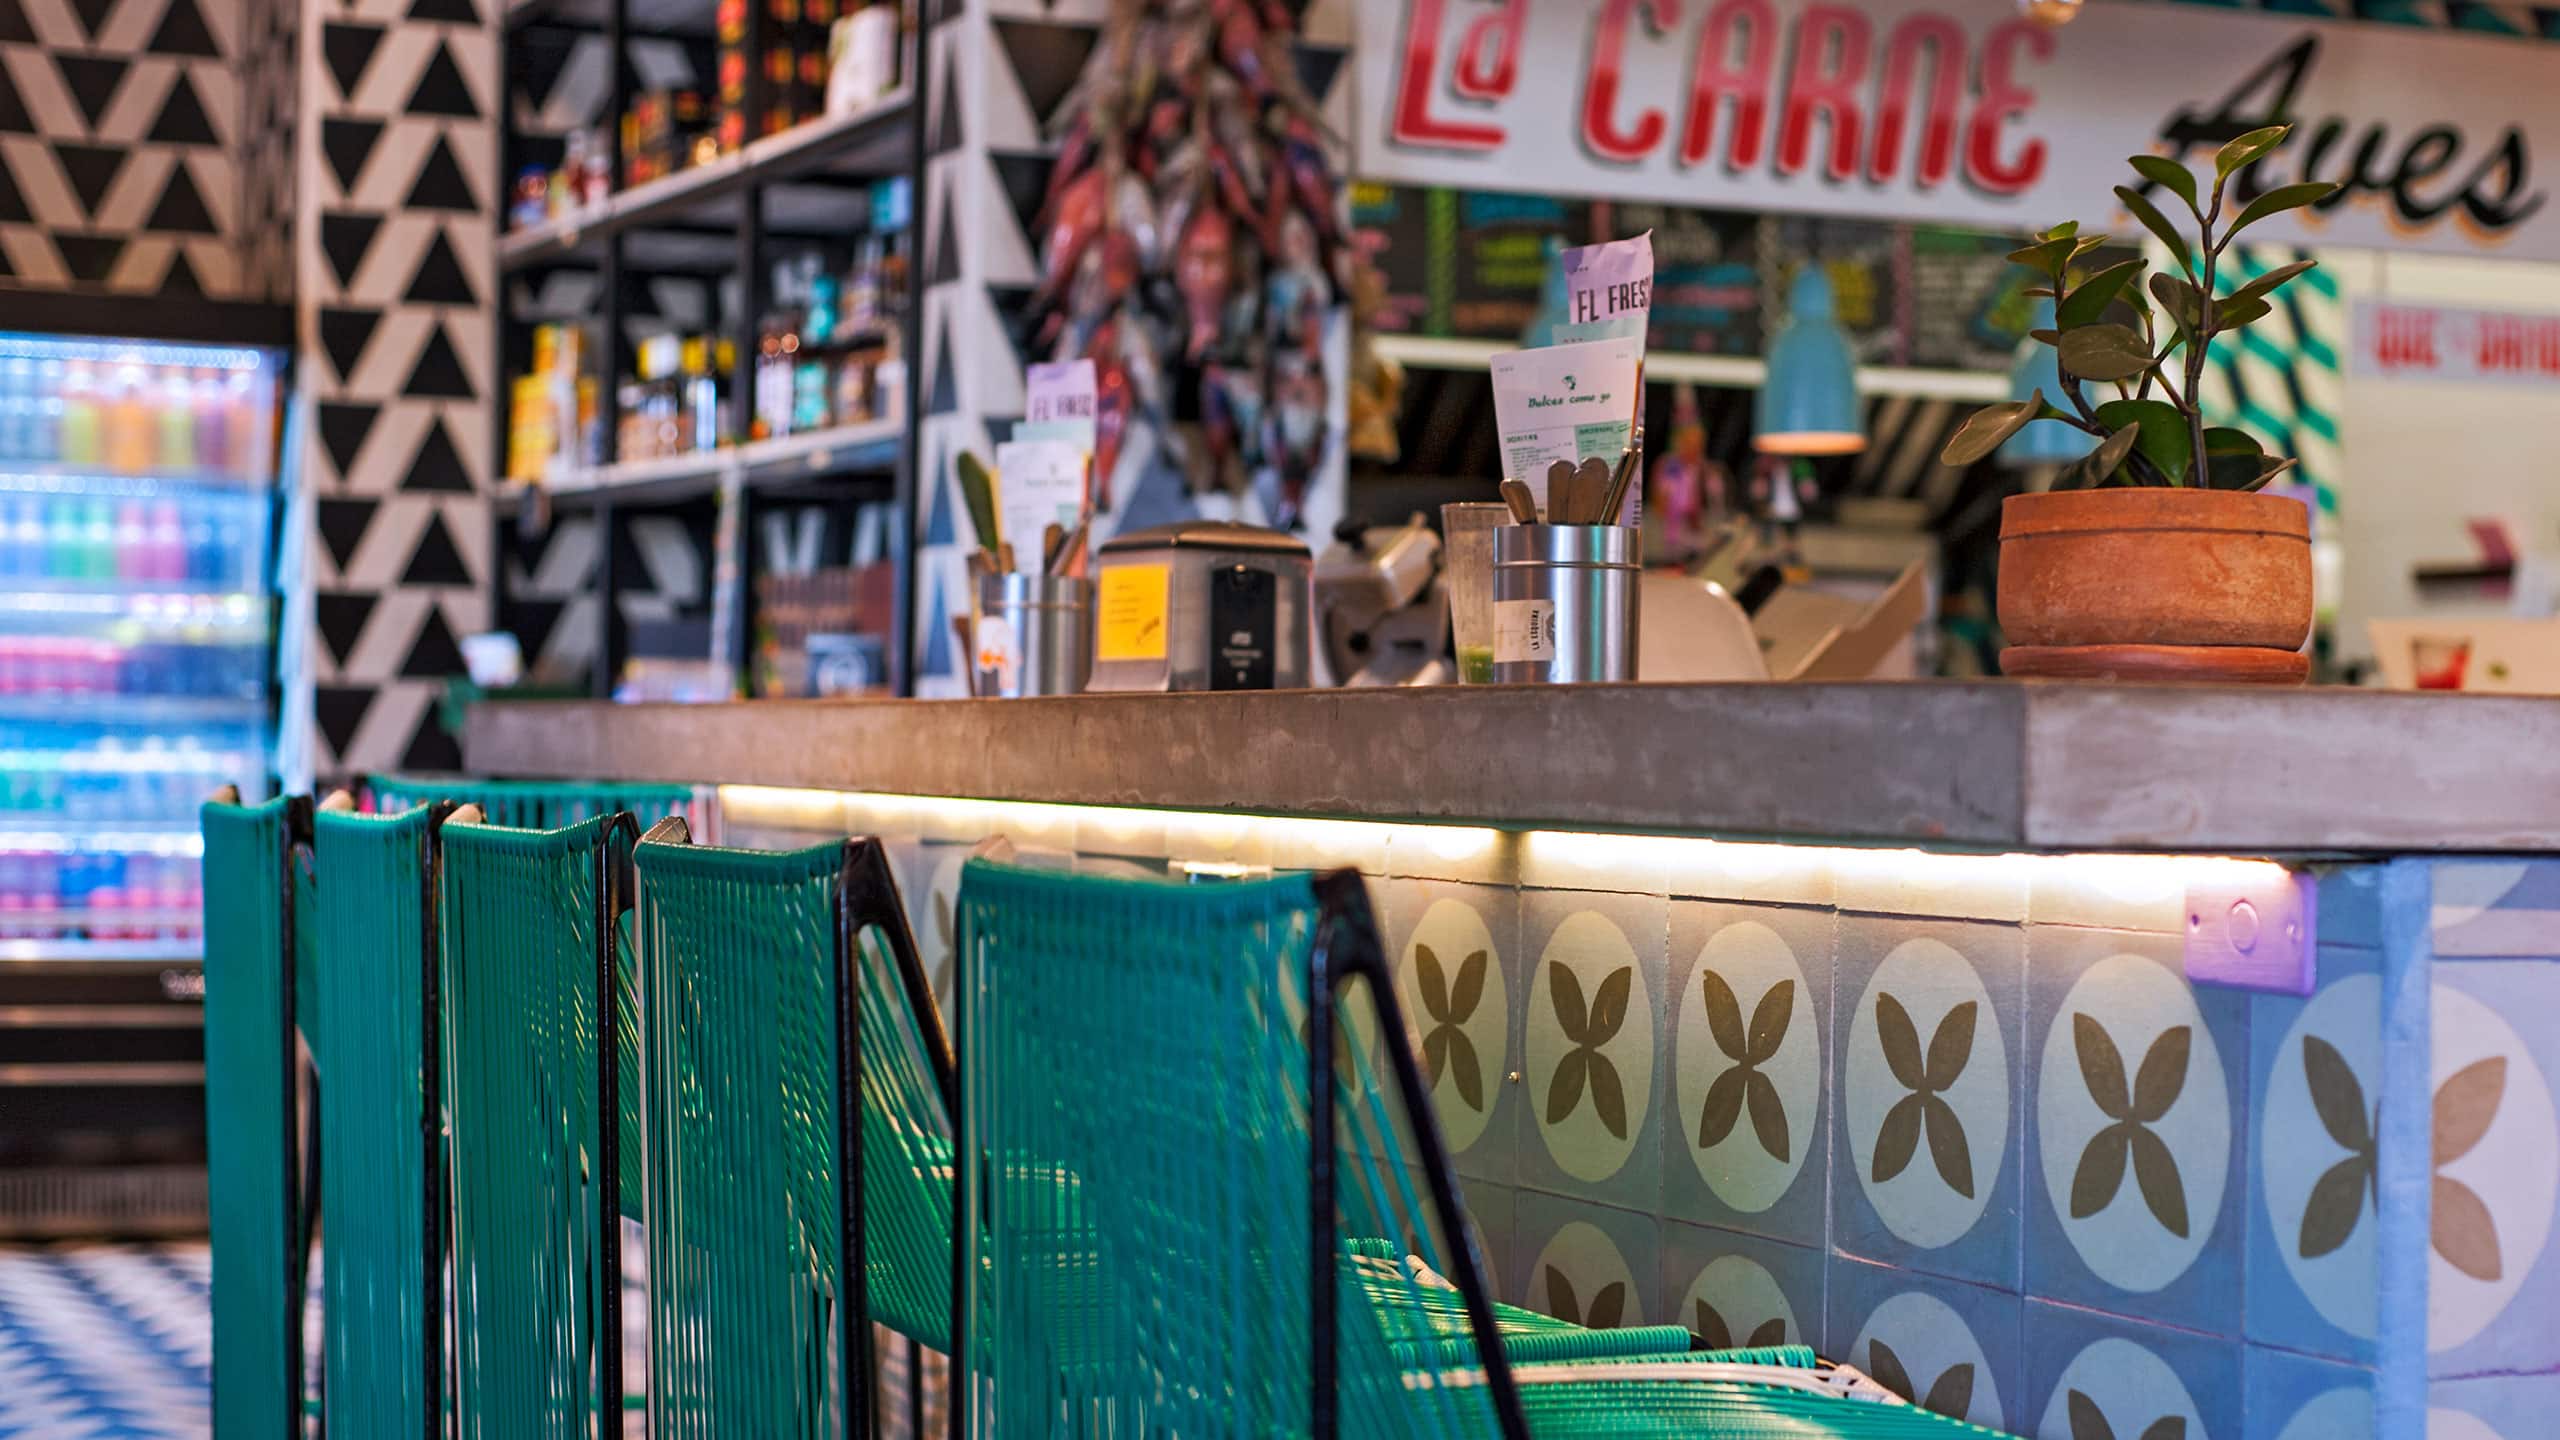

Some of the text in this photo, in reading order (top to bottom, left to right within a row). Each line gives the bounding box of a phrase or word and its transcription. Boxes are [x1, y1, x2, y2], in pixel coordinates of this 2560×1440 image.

[1578, 0, 2058, 196] CARNE
[2124, 32, 2550, 230] Aves
[1607, 277, 1651, 315] FRES
